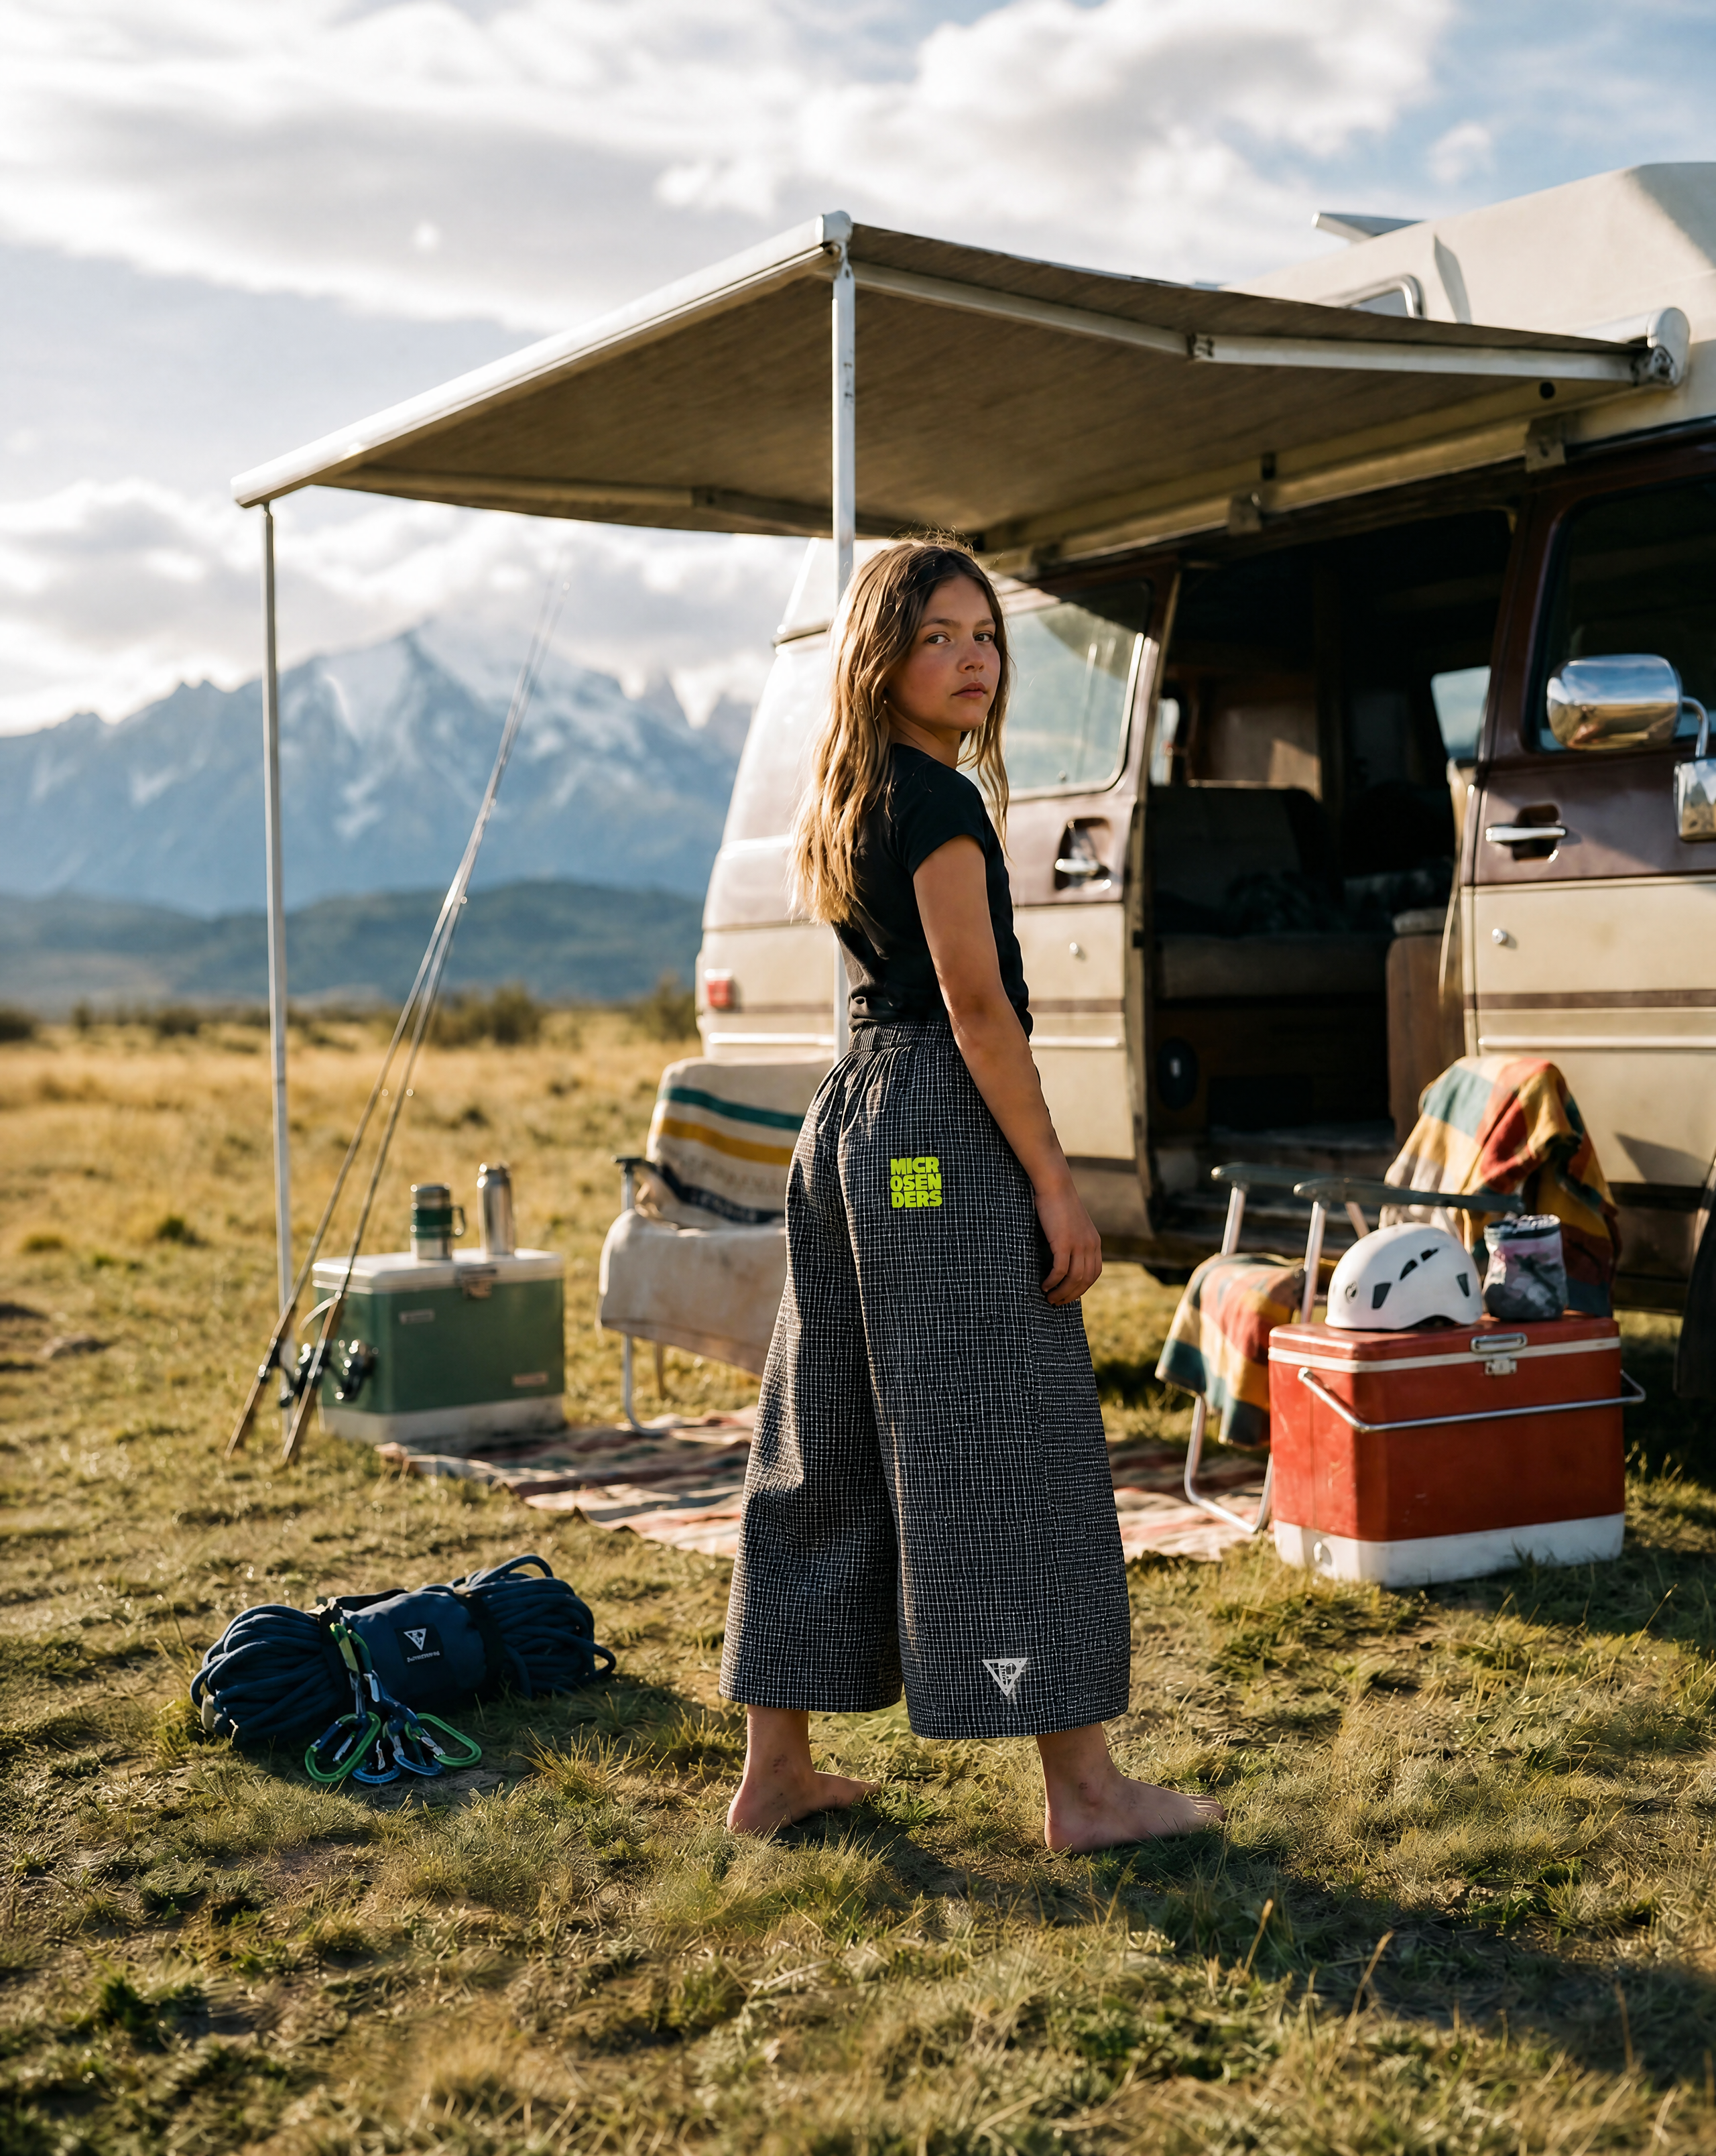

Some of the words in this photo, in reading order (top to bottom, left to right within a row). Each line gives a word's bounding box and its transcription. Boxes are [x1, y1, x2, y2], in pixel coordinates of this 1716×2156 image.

[890, 1156, 939, 1175] MICR
[890, 1173, 942, 1191] OSEN
[891, 1190, 942, 1208] DERS
